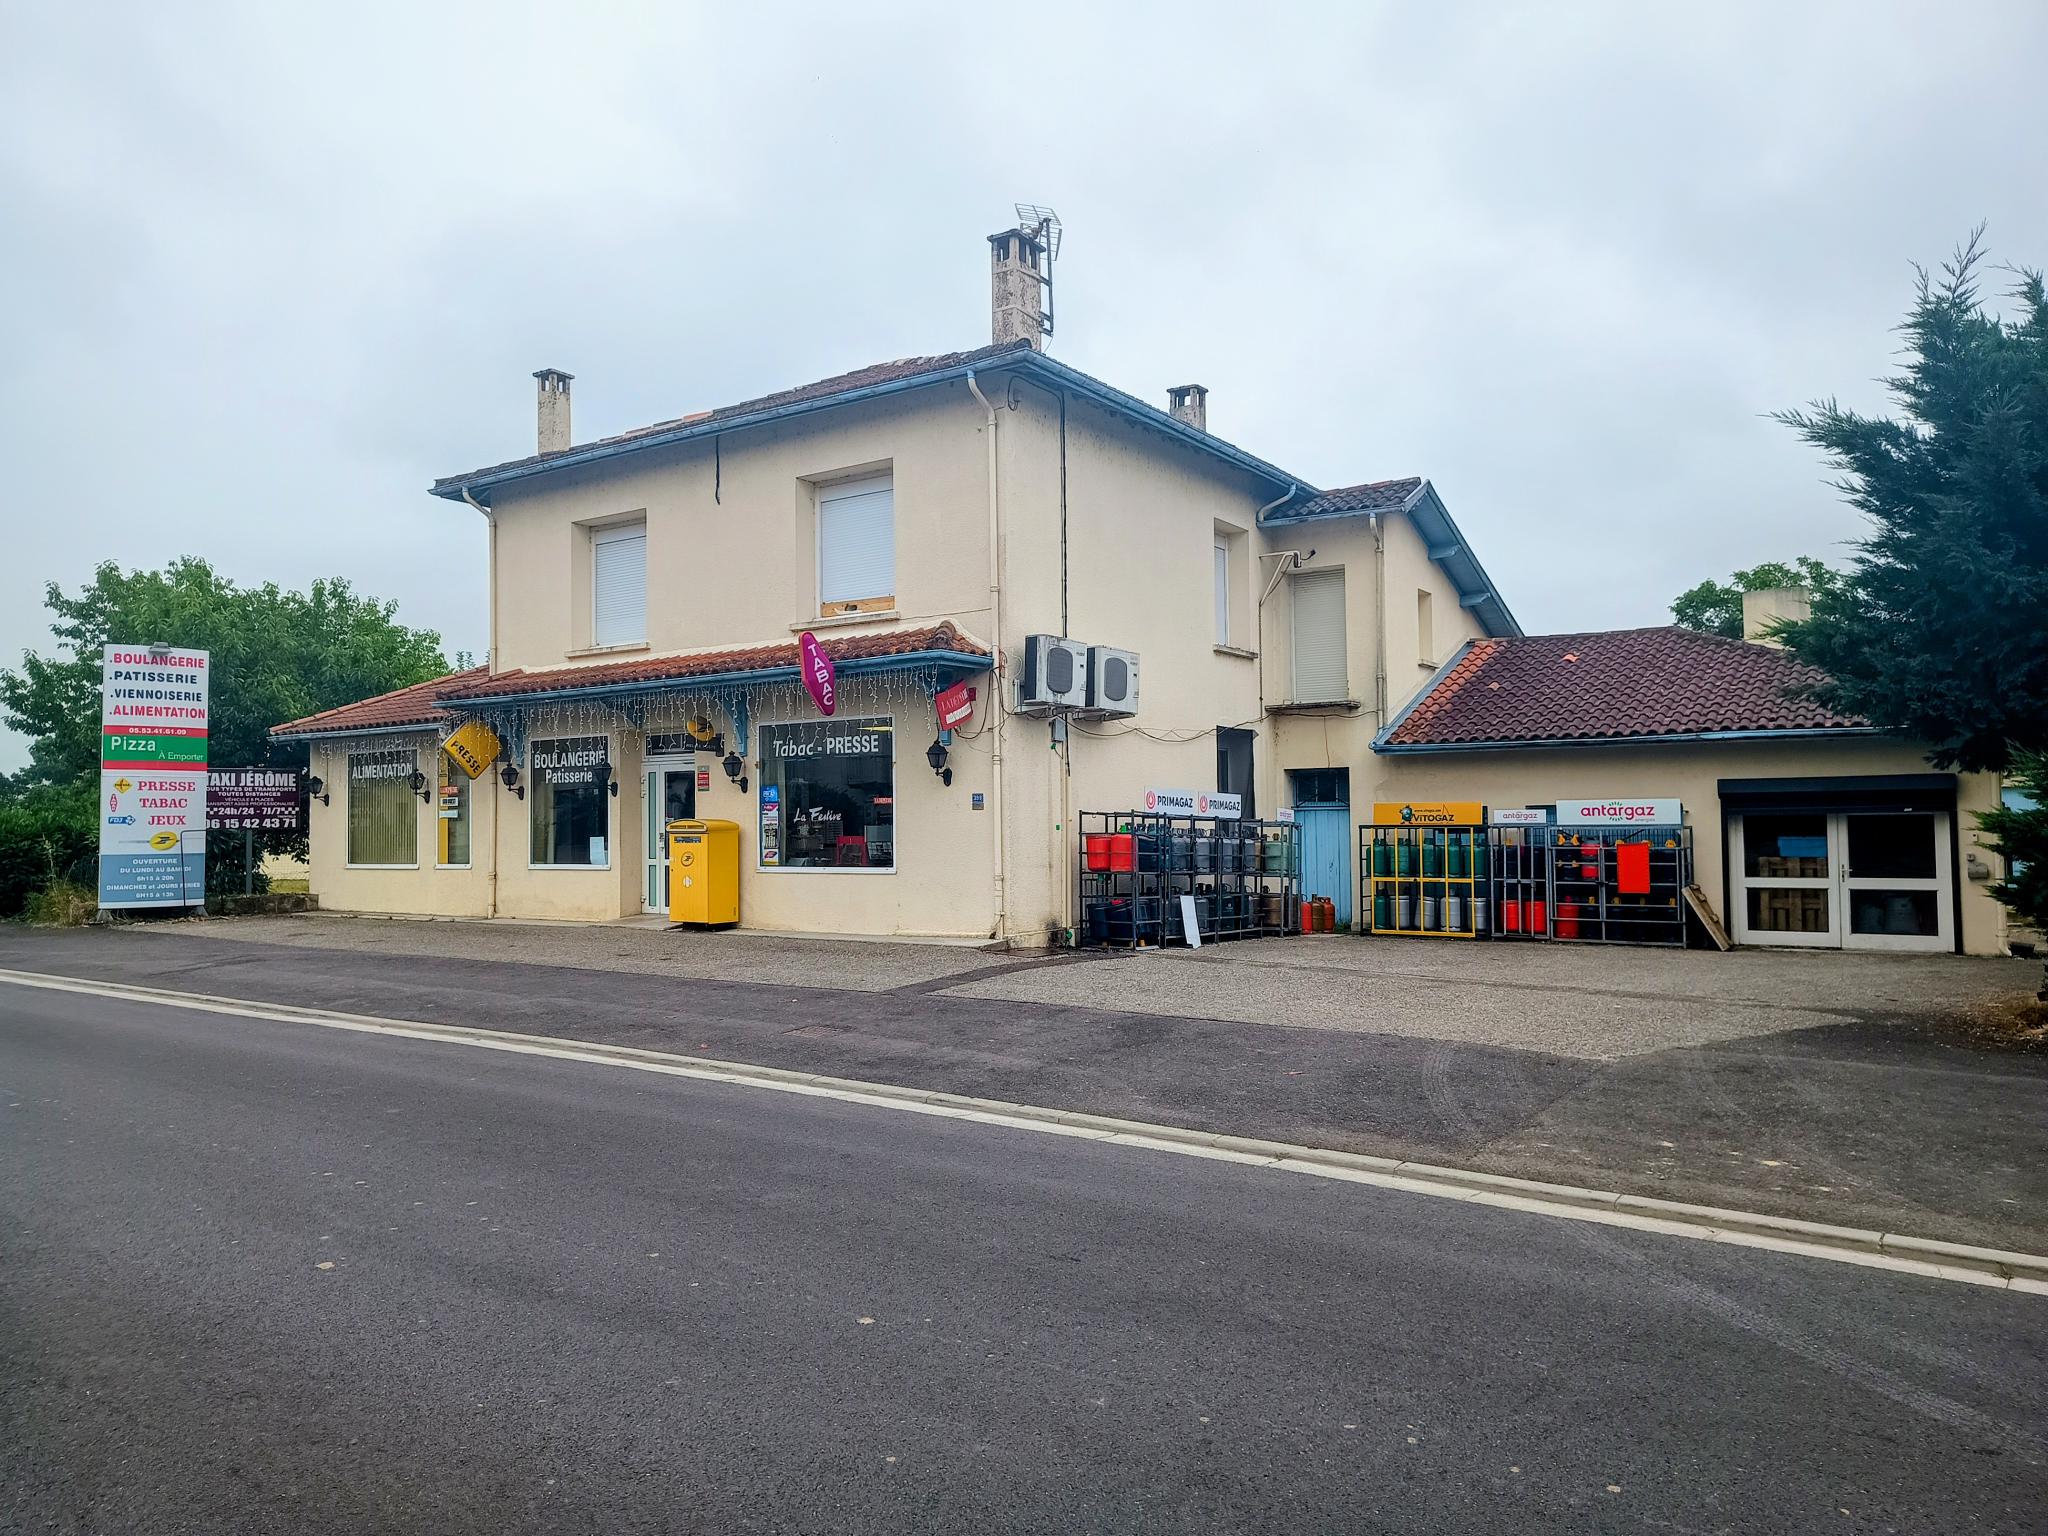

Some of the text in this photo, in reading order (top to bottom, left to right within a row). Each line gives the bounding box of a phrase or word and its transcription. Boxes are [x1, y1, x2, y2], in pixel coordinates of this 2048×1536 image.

[114, 653, 204, 668] BOULANGERIE
[114, 671, 197, 684] PATISSERIE
[808, 644, 833, 705] TABAC
[114, 689, 202, 701] VIENNOISERIE
[114, 705, 205, 718] ALIMENTATION
[111, 736, 156, 751] Pizza
[774, 740, 814, 757] Tabac
[826, 734, 878, 754] PRESSE
[168, 752, 204, 761] Emporter
[450, 740, 480, 774] PRESSE
[534, 750, 606, 768] BOULANGERIE
[240, 770, 296, 786] JÉRÔME
[352, 763, 412, 780] ALIMENTATION
[546, 768, 592, 784] Patisserie
[137, 781, 196, 792] PRESSE
[139, 798, 188, 808] TABAC
[1158, 796, 1193, 808] PRIMAGAZ
[1209, 800, 1240, 811] PRIMAGAZ
[1503, 812, 1538, 822] antargaz
[1580, 806, 1654, 820] antargaz
[148, 816, 186, 825] JEUX
[224, 818, 239, 828] 15
[242, 818, 259, 828] 42
[262, 818, 279, 828] 43
[283, 818, 296, 828] 71
